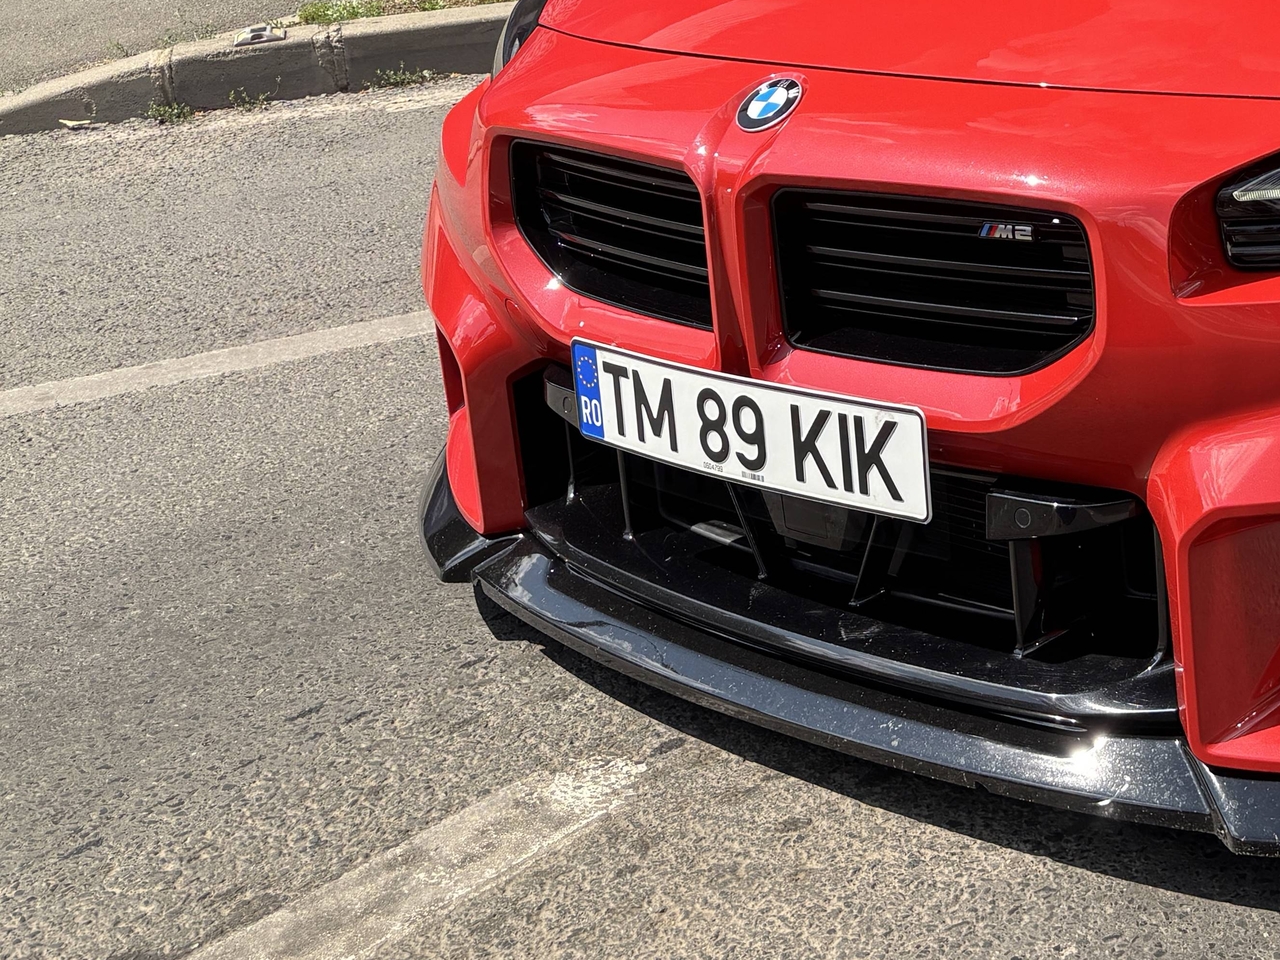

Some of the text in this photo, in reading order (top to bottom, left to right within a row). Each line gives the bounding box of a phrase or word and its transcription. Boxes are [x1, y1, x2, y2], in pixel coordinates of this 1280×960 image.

[581, 394, 602, 428] RO
[602, 361, 905, 504] TM 89 KIK
